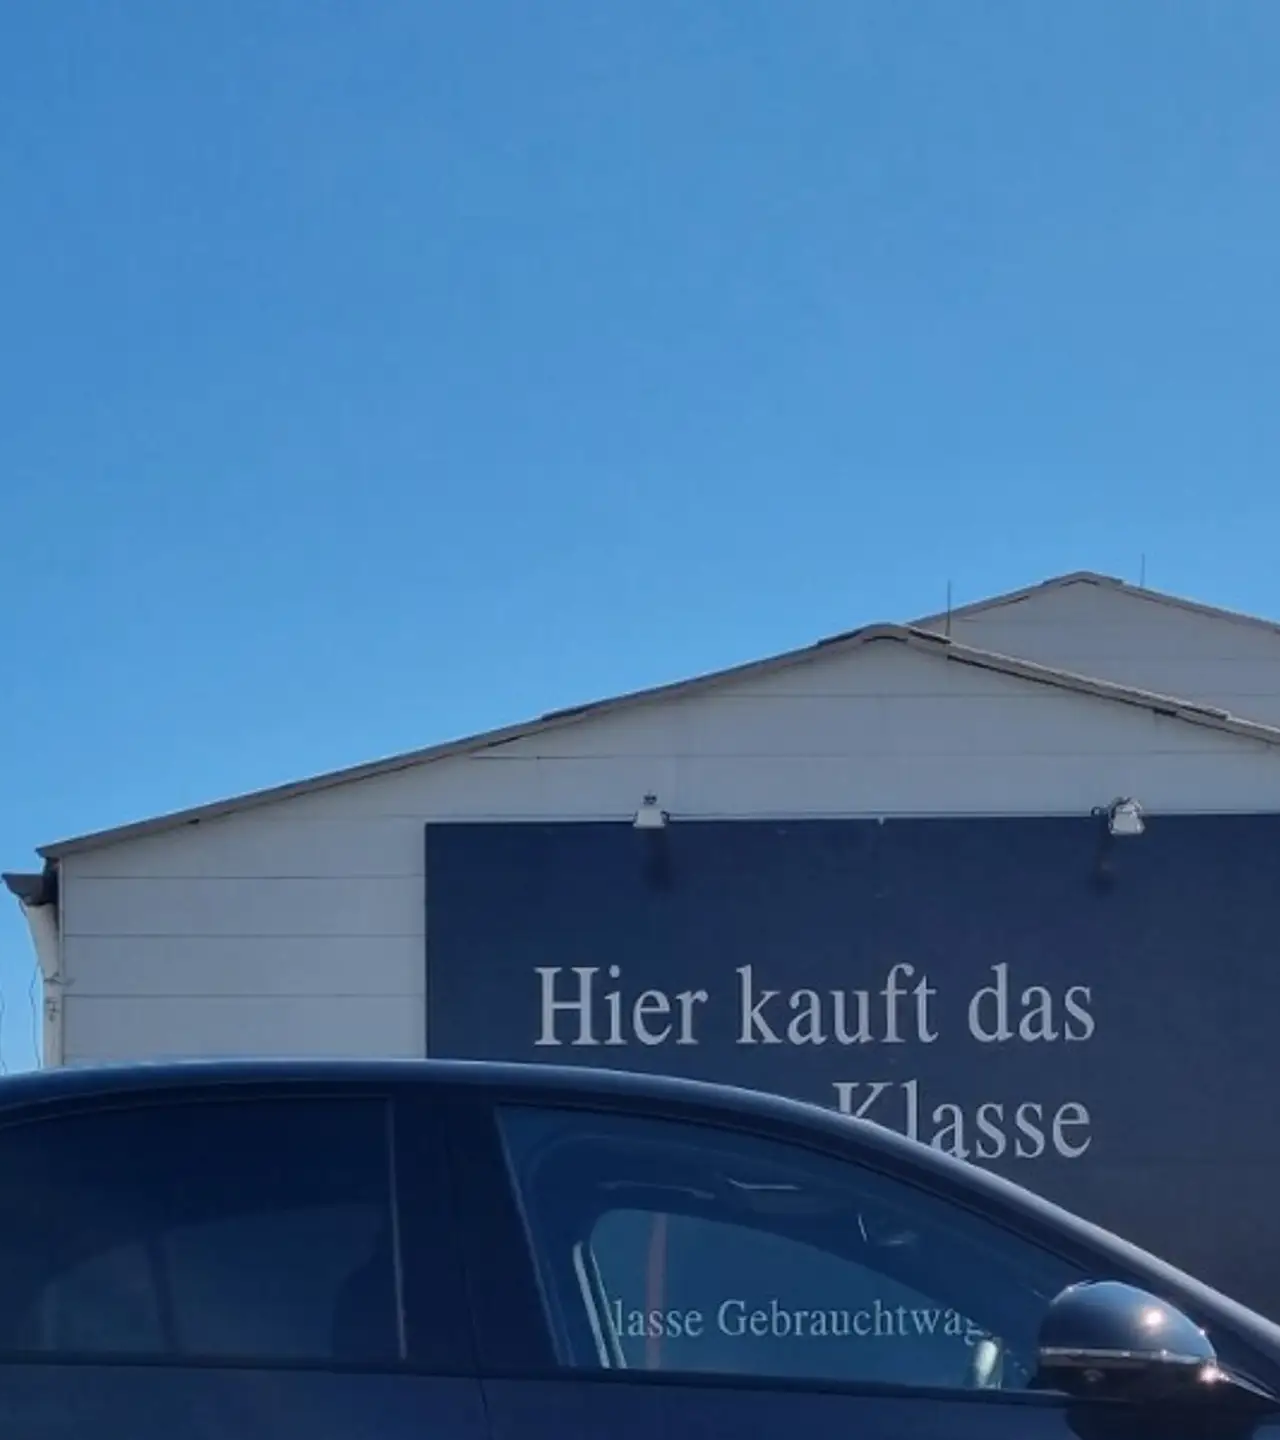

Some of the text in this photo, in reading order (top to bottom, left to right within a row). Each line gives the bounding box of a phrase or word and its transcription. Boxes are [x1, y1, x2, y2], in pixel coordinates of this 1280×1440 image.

[535, 962, 1095, 1045] Hier kauft das
[612, 1297, 986, 1347] lasse Gebrauchtwag
